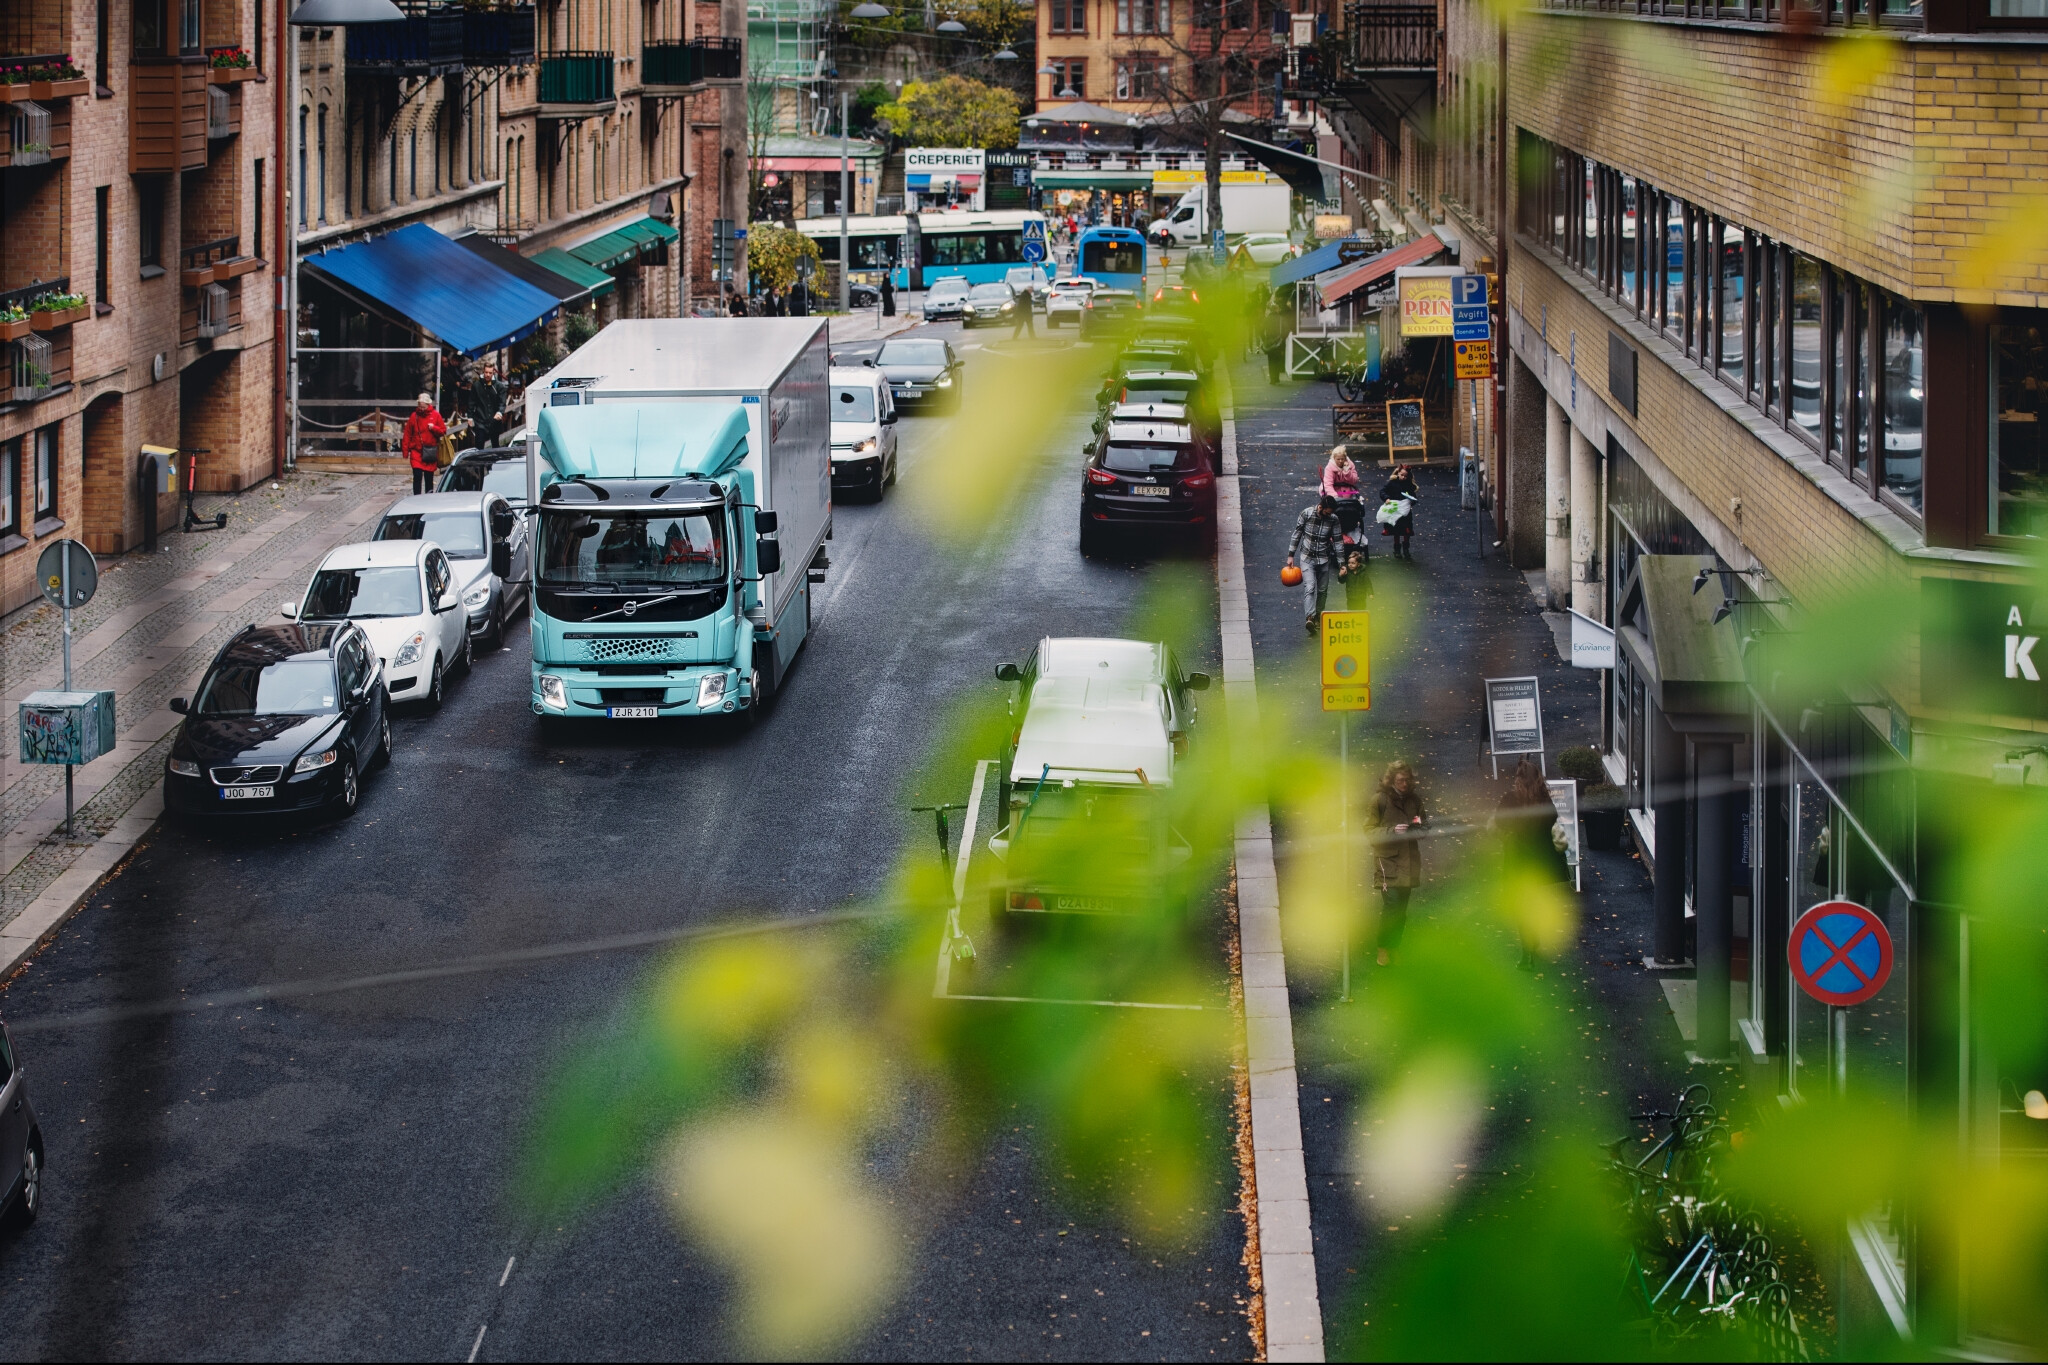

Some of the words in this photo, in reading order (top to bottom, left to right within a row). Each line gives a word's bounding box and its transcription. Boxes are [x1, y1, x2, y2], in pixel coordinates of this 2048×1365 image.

[908, 154, 982, 165] CREPERIET
[498, 236, 517, 245] ITALIA
[1461, 278, 1479, 303] P
[1458, 310, 1484, 320] Avgift
[1469, 344, 1487, 352] Tisd
[1468, 353, 1488, 361] 8-10
[2006, 605, 2022, 626] A
[1328, 618, 1363, 630] Last-
[1329, 633, 1362, 647] plats
[1573, 642, 1611, 652] Exuviance
[2005, 634, 2040, 681] K
[1327, 694, 1354, 704] 0-10
[1356, 695, 1365, 703] m
[615, 708, 633, 717] ZJR
[636, 708, 654, 717] 210
[251, 787, 271, 797] 767
[1741, 812, 1749, 821] 12
[1741, 824, 1750, 864] Prinsgatan
